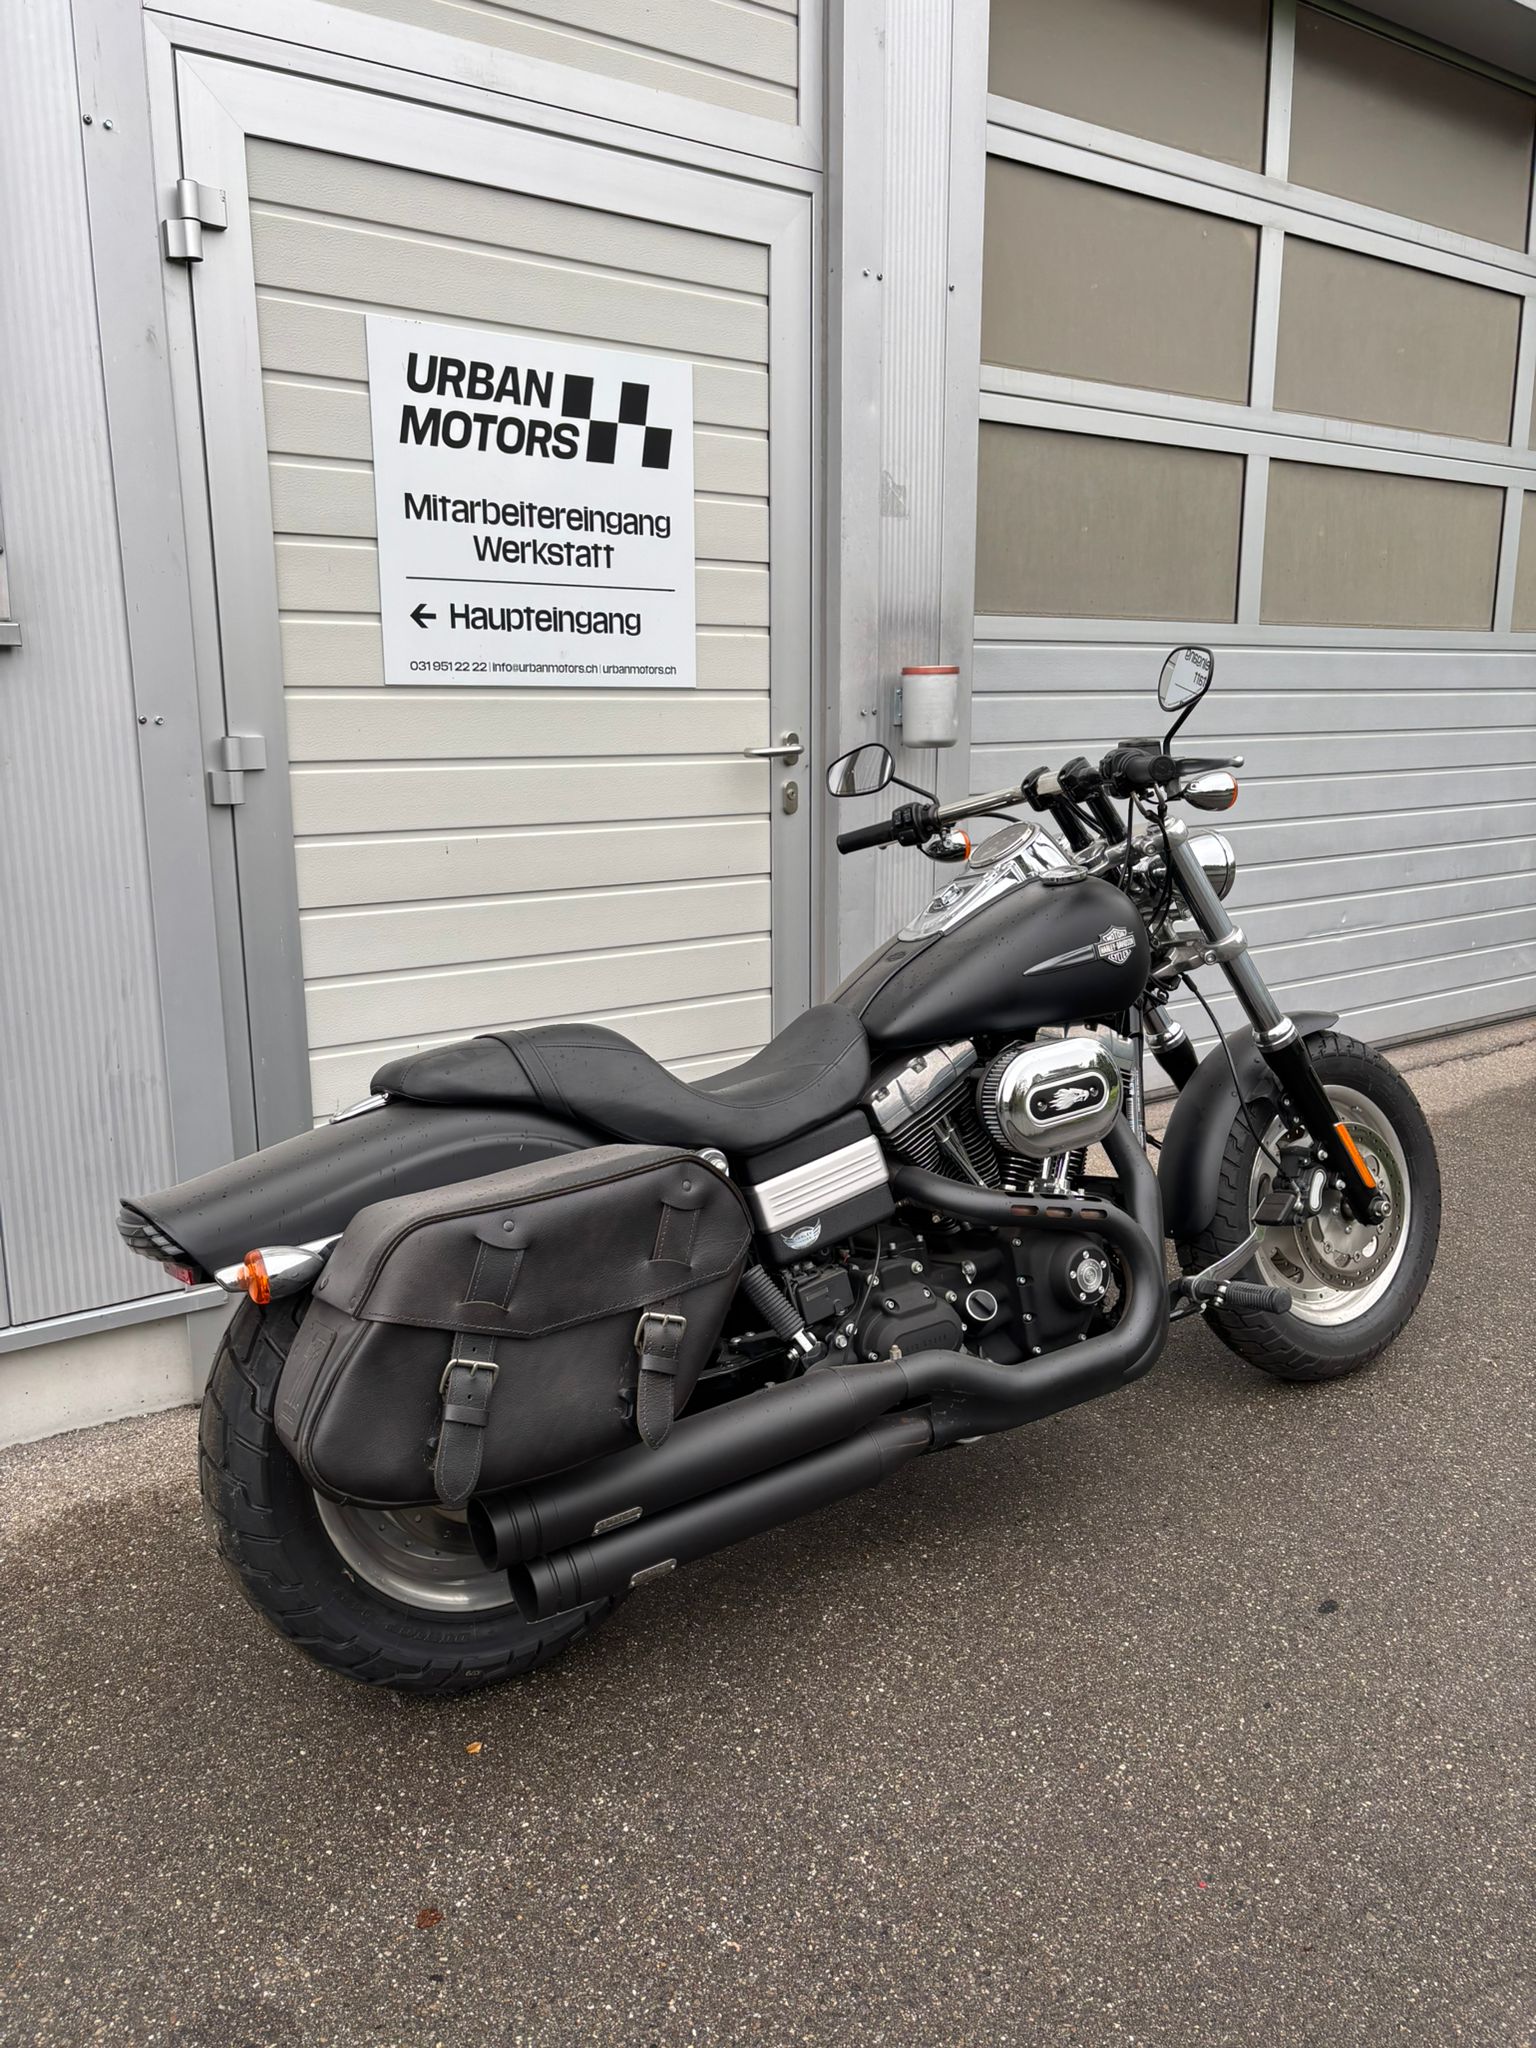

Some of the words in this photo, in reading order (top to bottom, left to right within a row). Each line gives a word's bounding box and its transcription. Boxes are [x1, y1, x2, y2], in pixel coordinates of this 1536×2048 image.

[407, 352, 554, 409] URBAN
[400, 405, 580, 460] MOTORS
[404, 493, 671, 538] Mitarbeitereingang
[473, 535, 615, 568] Werkstatt
[450, 603, 641, 636] Haupteingang
[602, 664, 677, 675] urbanmotors.ch
